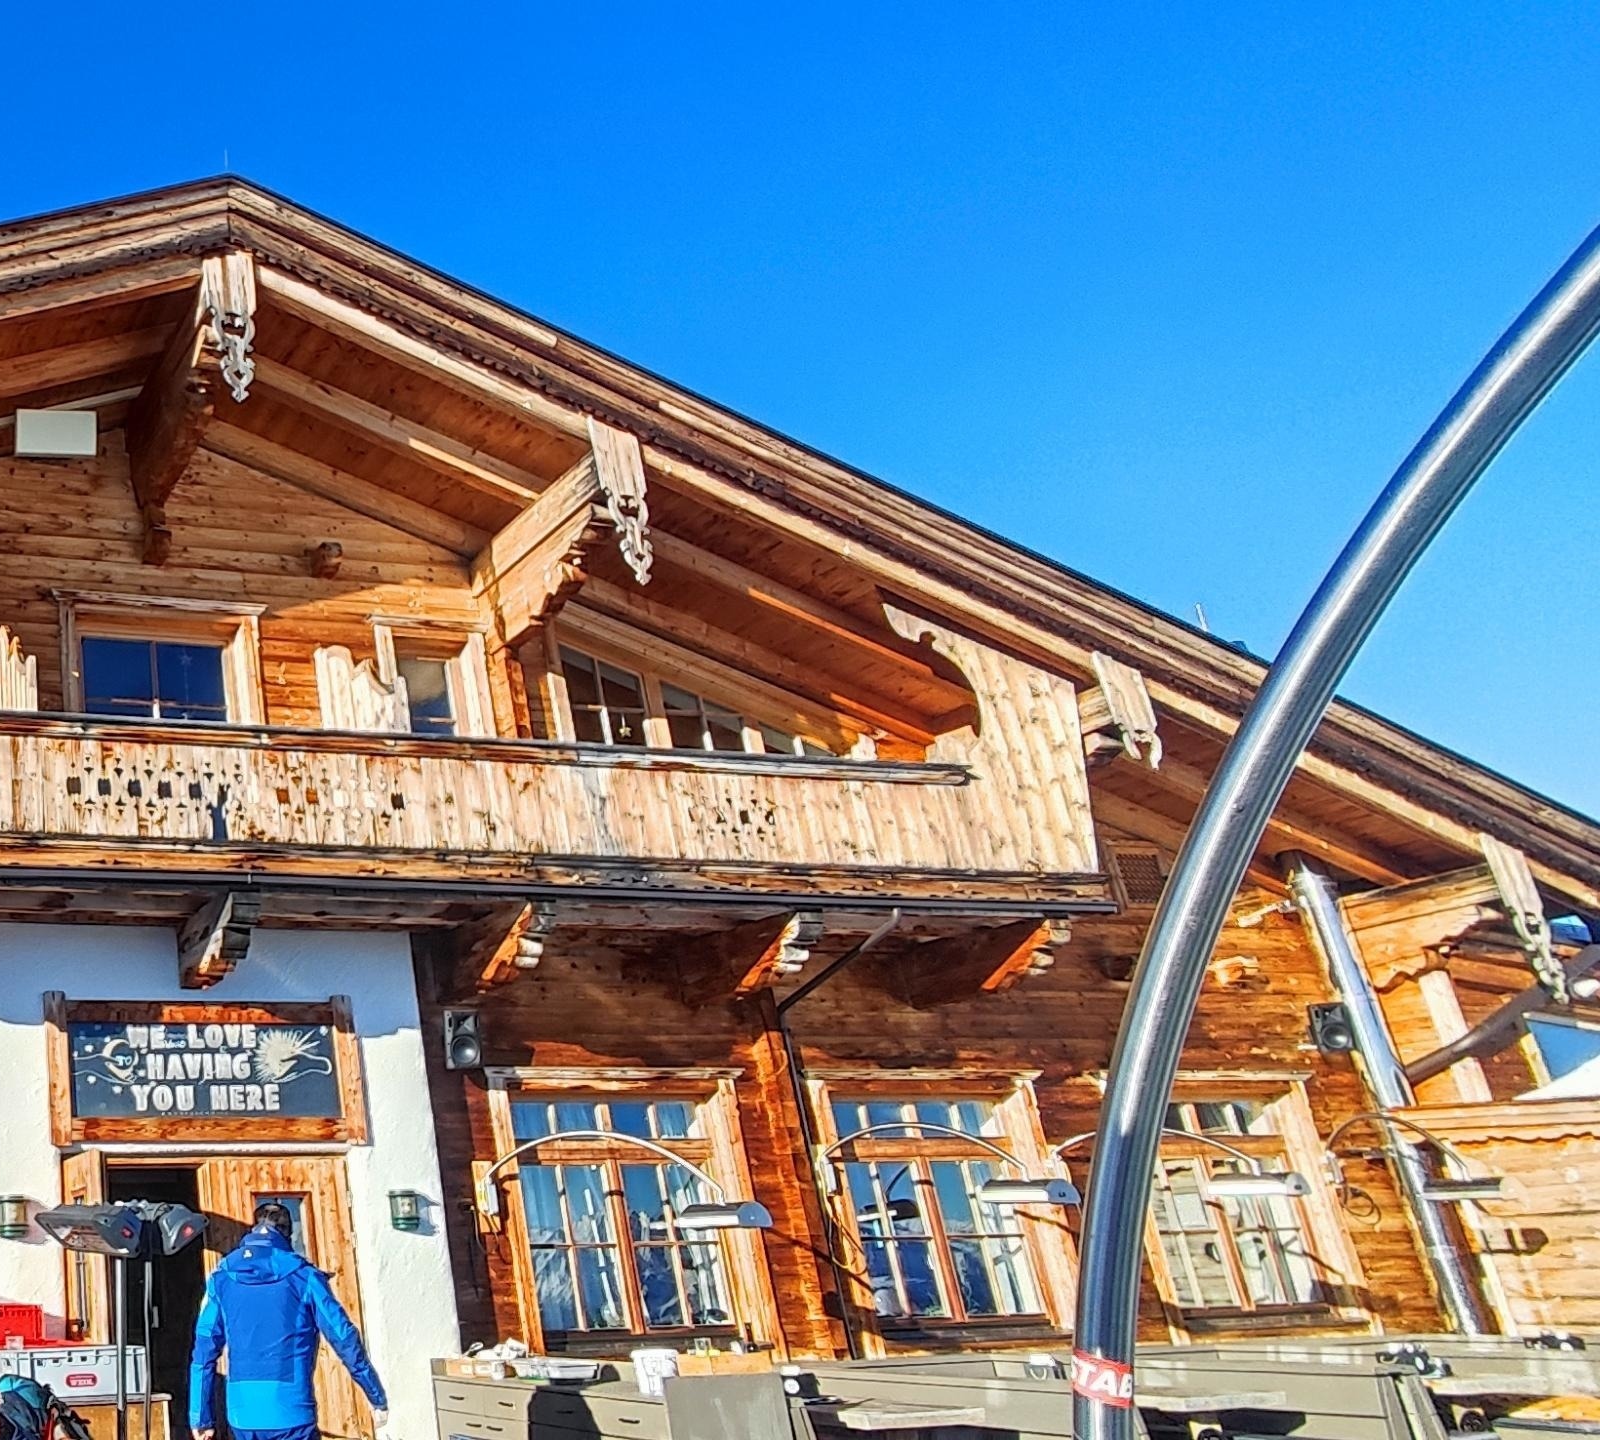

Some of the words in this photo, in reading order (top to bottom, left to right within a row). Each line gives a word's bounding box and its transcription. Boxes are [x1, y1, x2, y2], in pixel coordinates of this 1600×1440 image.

[126, 1024, 165, 1049] WE
[187, 1023, 257, 1048] LOVE
[146, 1053, 251, 1080] HAVING
[131, 1084, 195, 1111] YOU
[210, 1084, 280, 1111] HERE
